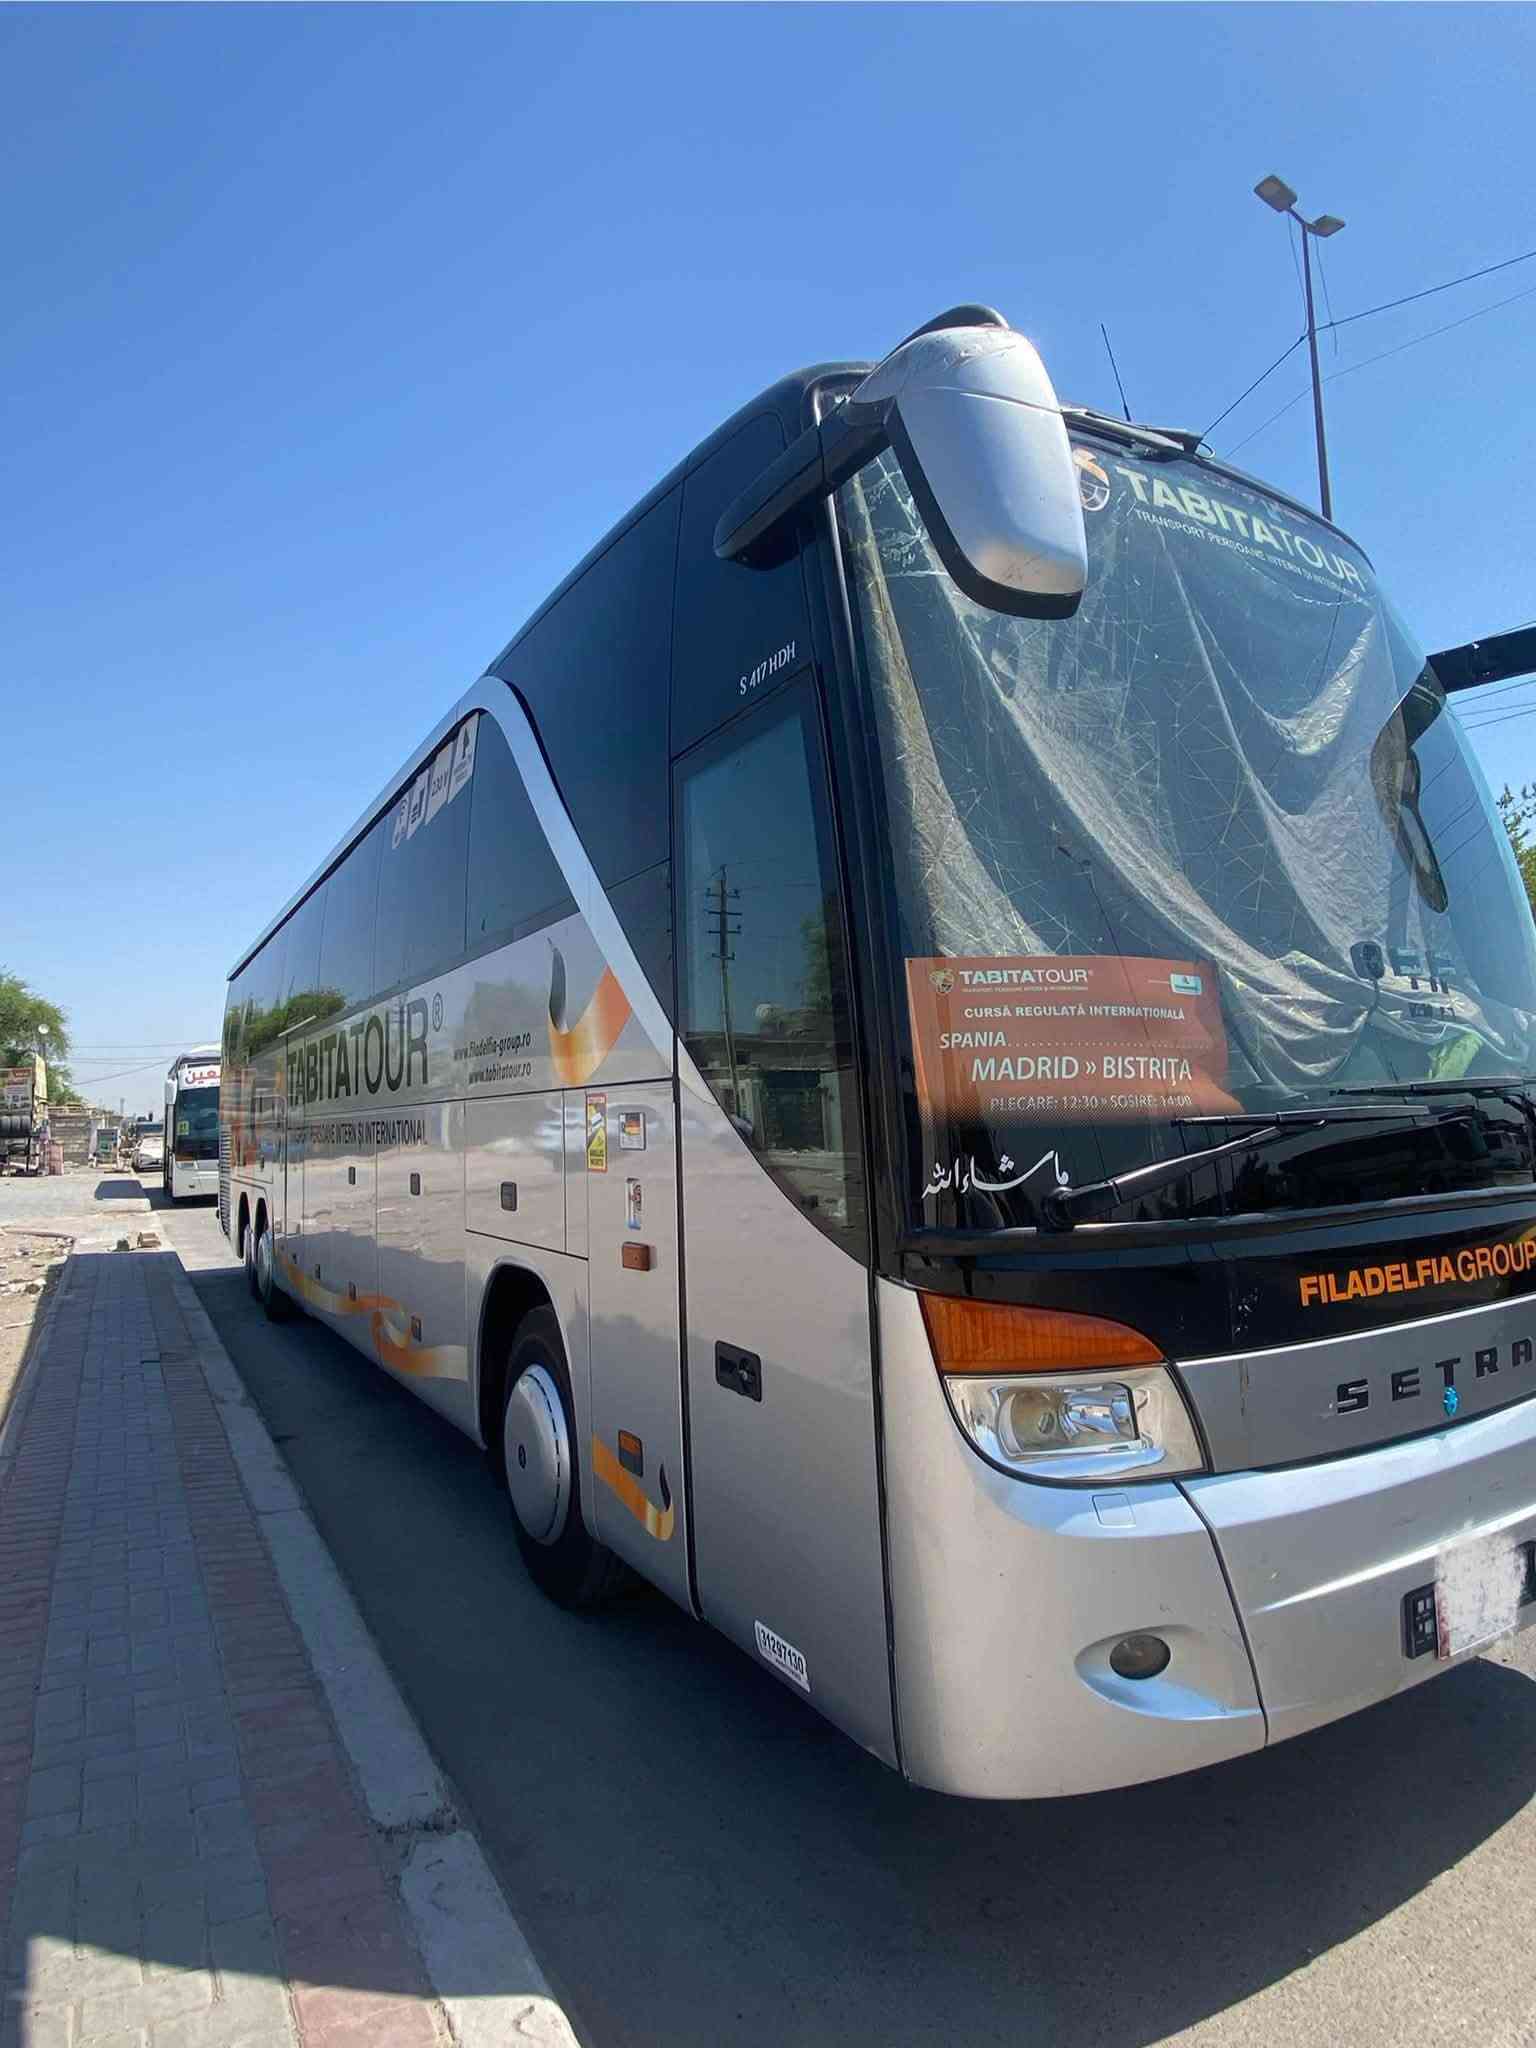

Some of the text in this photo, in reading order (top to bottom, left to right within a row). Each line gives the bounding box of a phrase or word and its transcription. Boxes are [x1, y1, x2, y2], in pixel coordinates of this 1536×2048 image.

[1114, 465, 1366, 593] TABITATOUR
[740, 639, 796, 696] S 417 HDH
[958, 968, 1089, 985] TABITATOUR
[971, 1055, 1079, 1082] MADRID
[1335, 1336, 1533, 1415] SETRA
